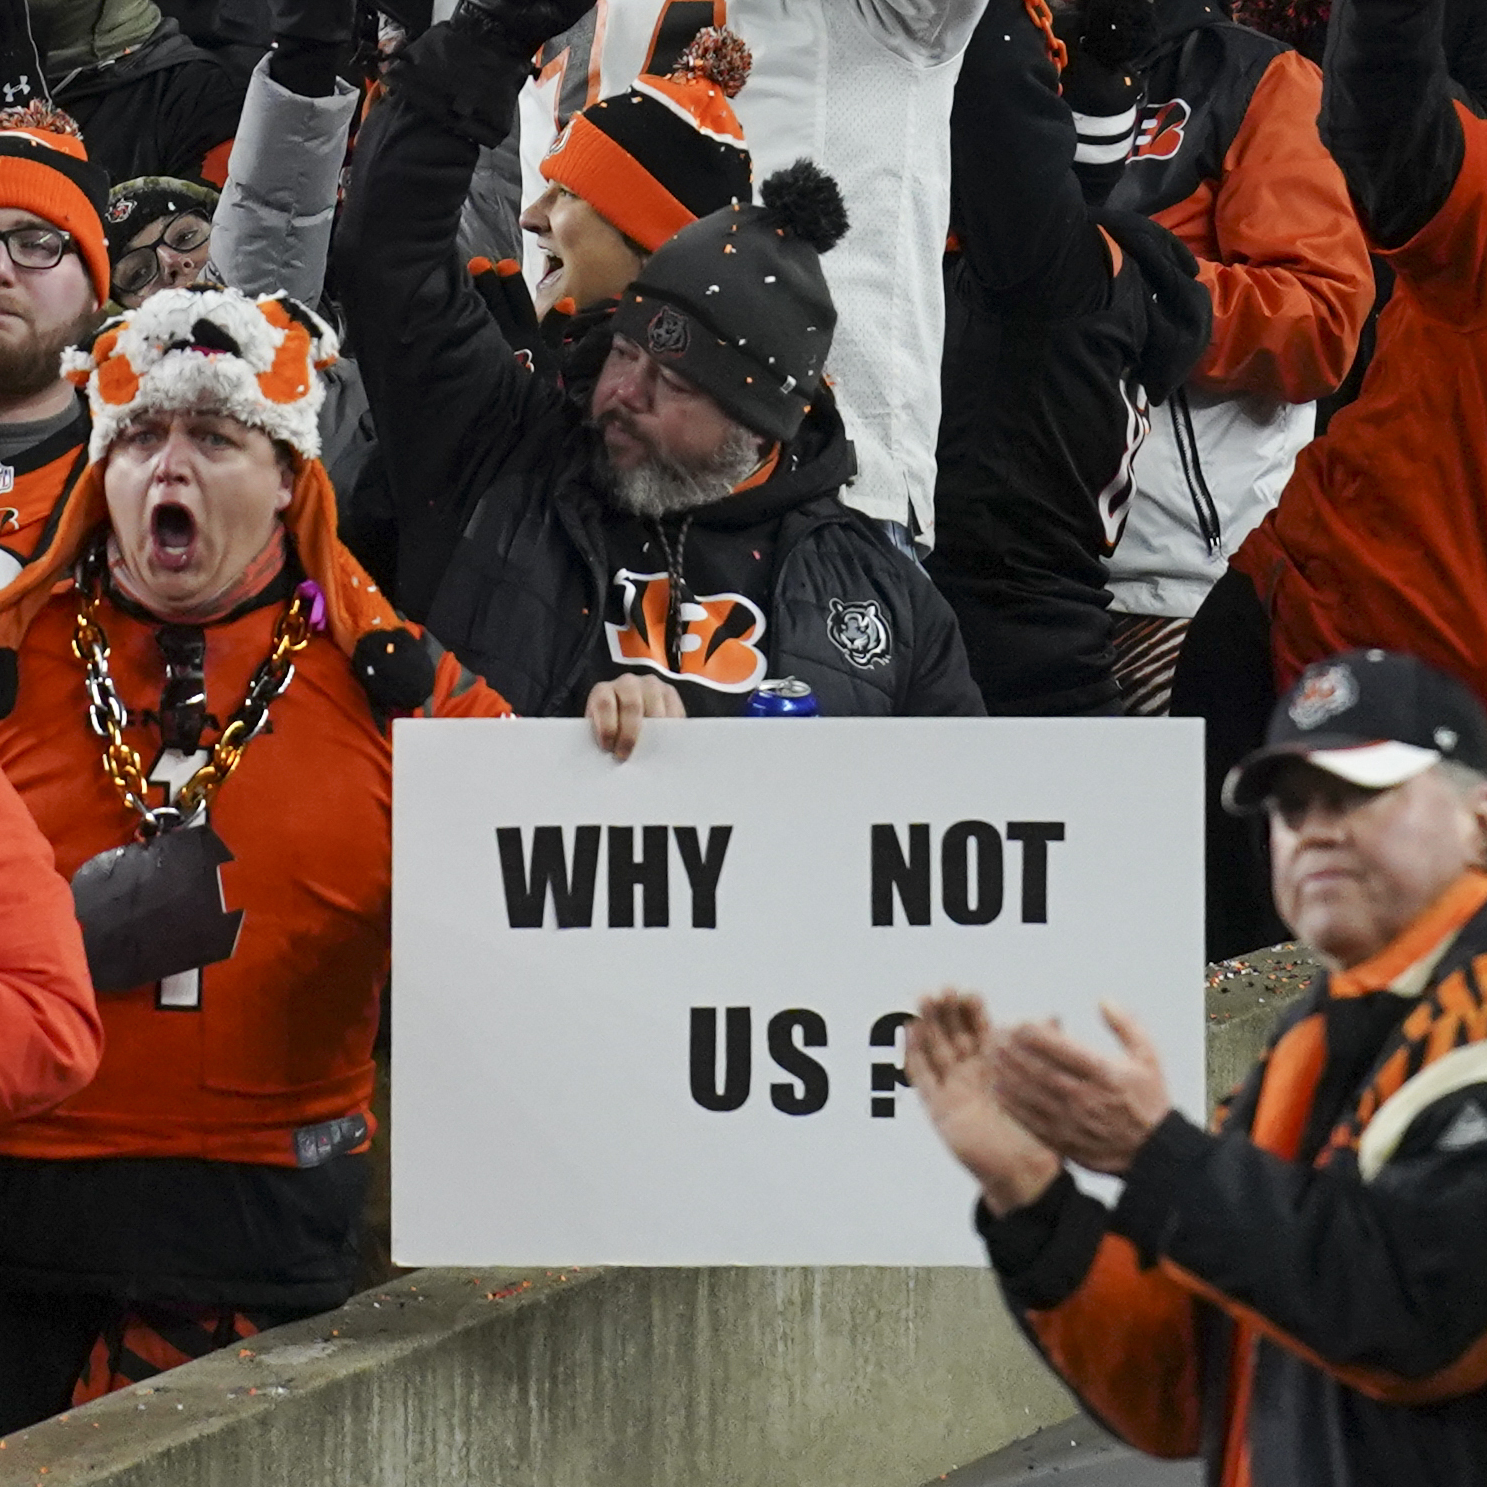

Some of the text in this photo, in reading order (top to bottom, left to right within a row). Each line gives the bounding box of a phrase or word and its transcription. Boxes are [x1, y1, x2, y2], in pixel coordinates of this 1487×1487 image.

[495, 819, 1066, 930] WHY NOT
[688, 1006, 831, 1116] US
